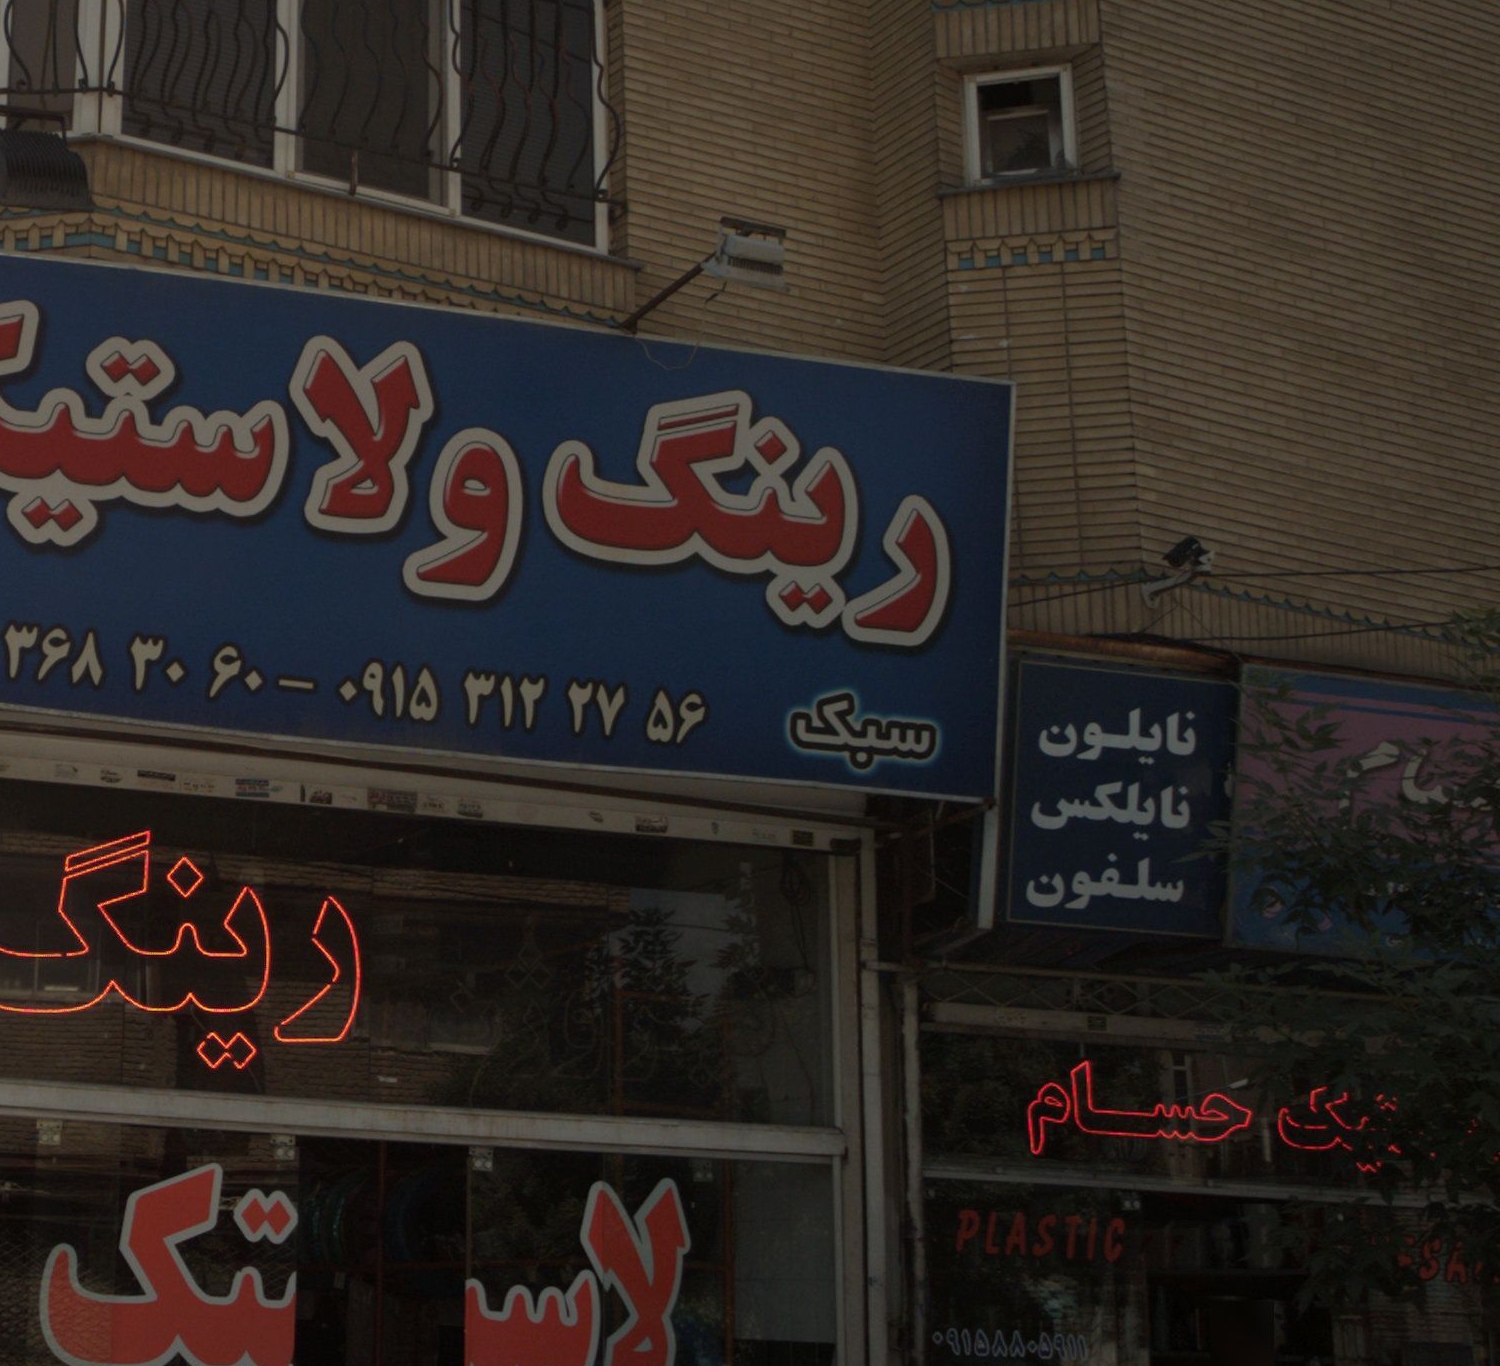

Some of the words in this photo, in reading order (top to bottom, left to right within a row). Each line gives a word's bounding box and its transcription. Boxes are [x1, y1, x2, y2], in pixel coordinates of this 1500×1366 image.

[402, 427, 524, 602] و
[542, 389, 952, 647] رینگ
[789, 690, 937, 770] سبک
[1038, 707, 1196, 765] نایلون
[1030, 780, 1192, 842] نایلکس
[1025, 852, 1185, 910] سلفون
[1027, 1058, 1252, 1156] حسام
[954, 1207, 1127, 1264] PLASTIC
